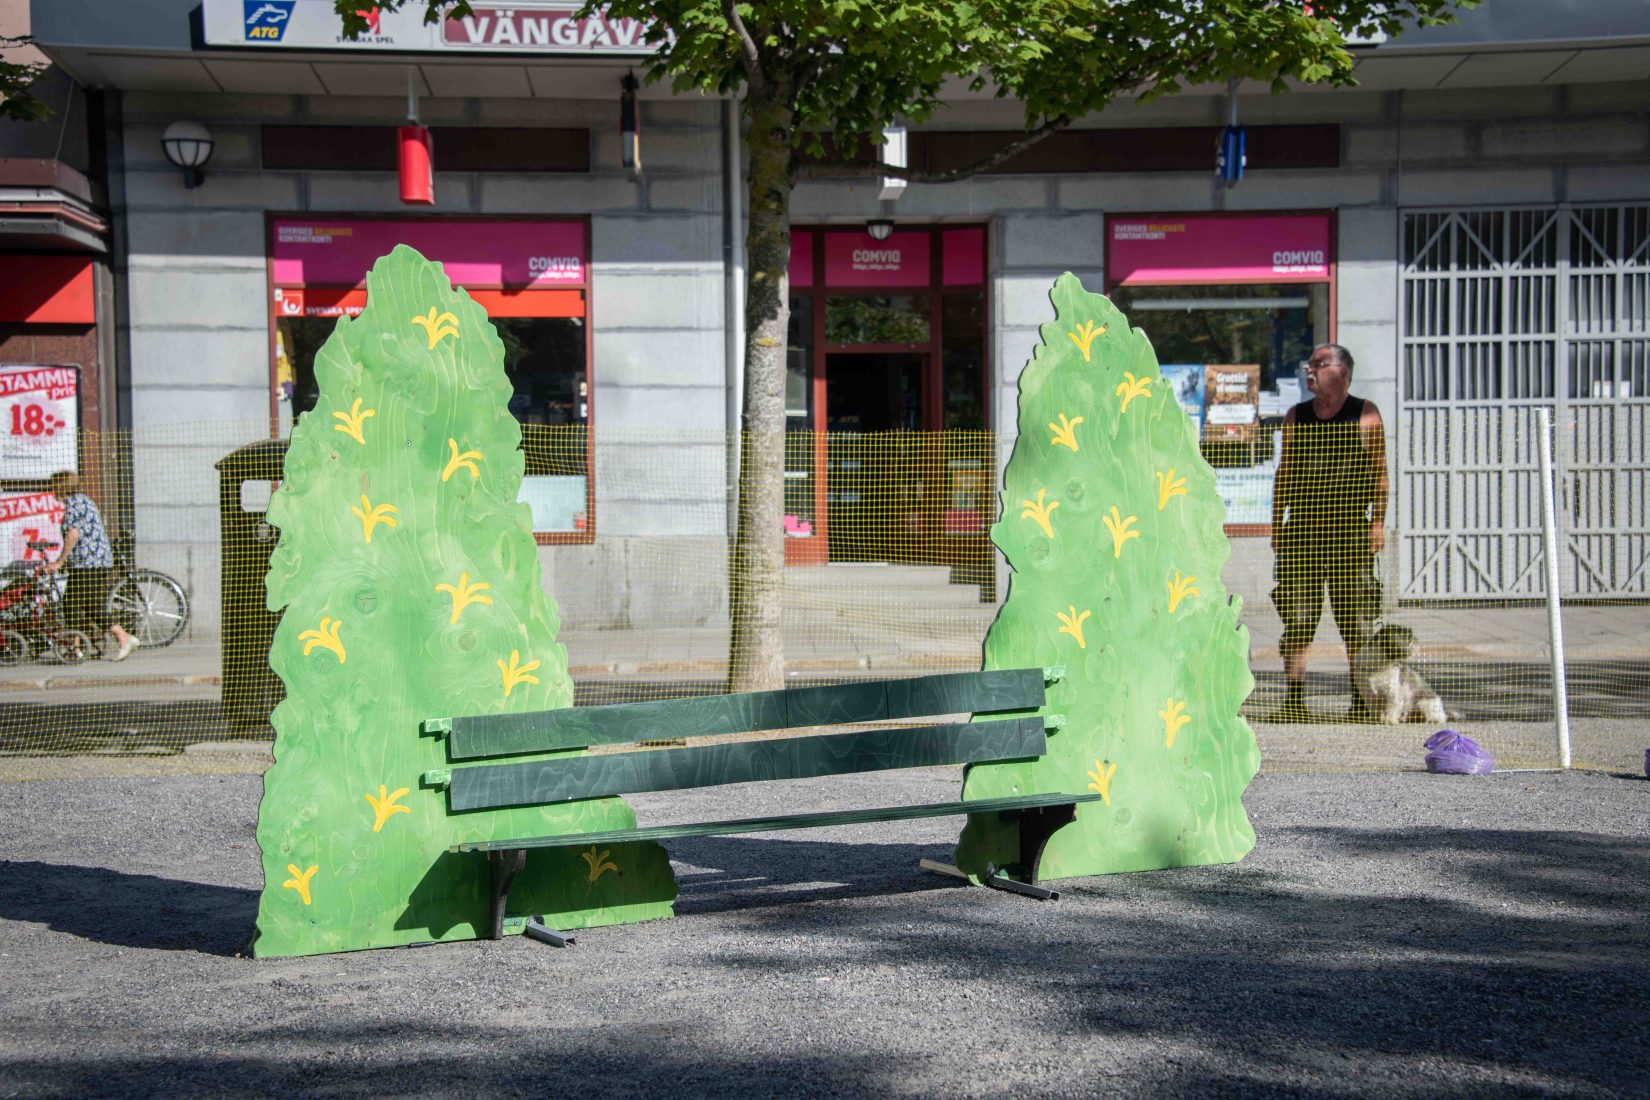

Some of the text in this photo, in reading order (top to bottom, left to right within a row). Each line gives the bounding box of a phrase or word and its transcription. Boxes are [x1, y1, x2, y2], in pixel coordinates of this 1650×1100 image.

[248, 26, 279, 38] ATG
[853, 249, 901, 262] COMVIQ
[1273, 250, 1324, 265] COMVIQ
[528, 256, 580, 271] COMVIQ
[11, 404, 65, 436] 18:-
